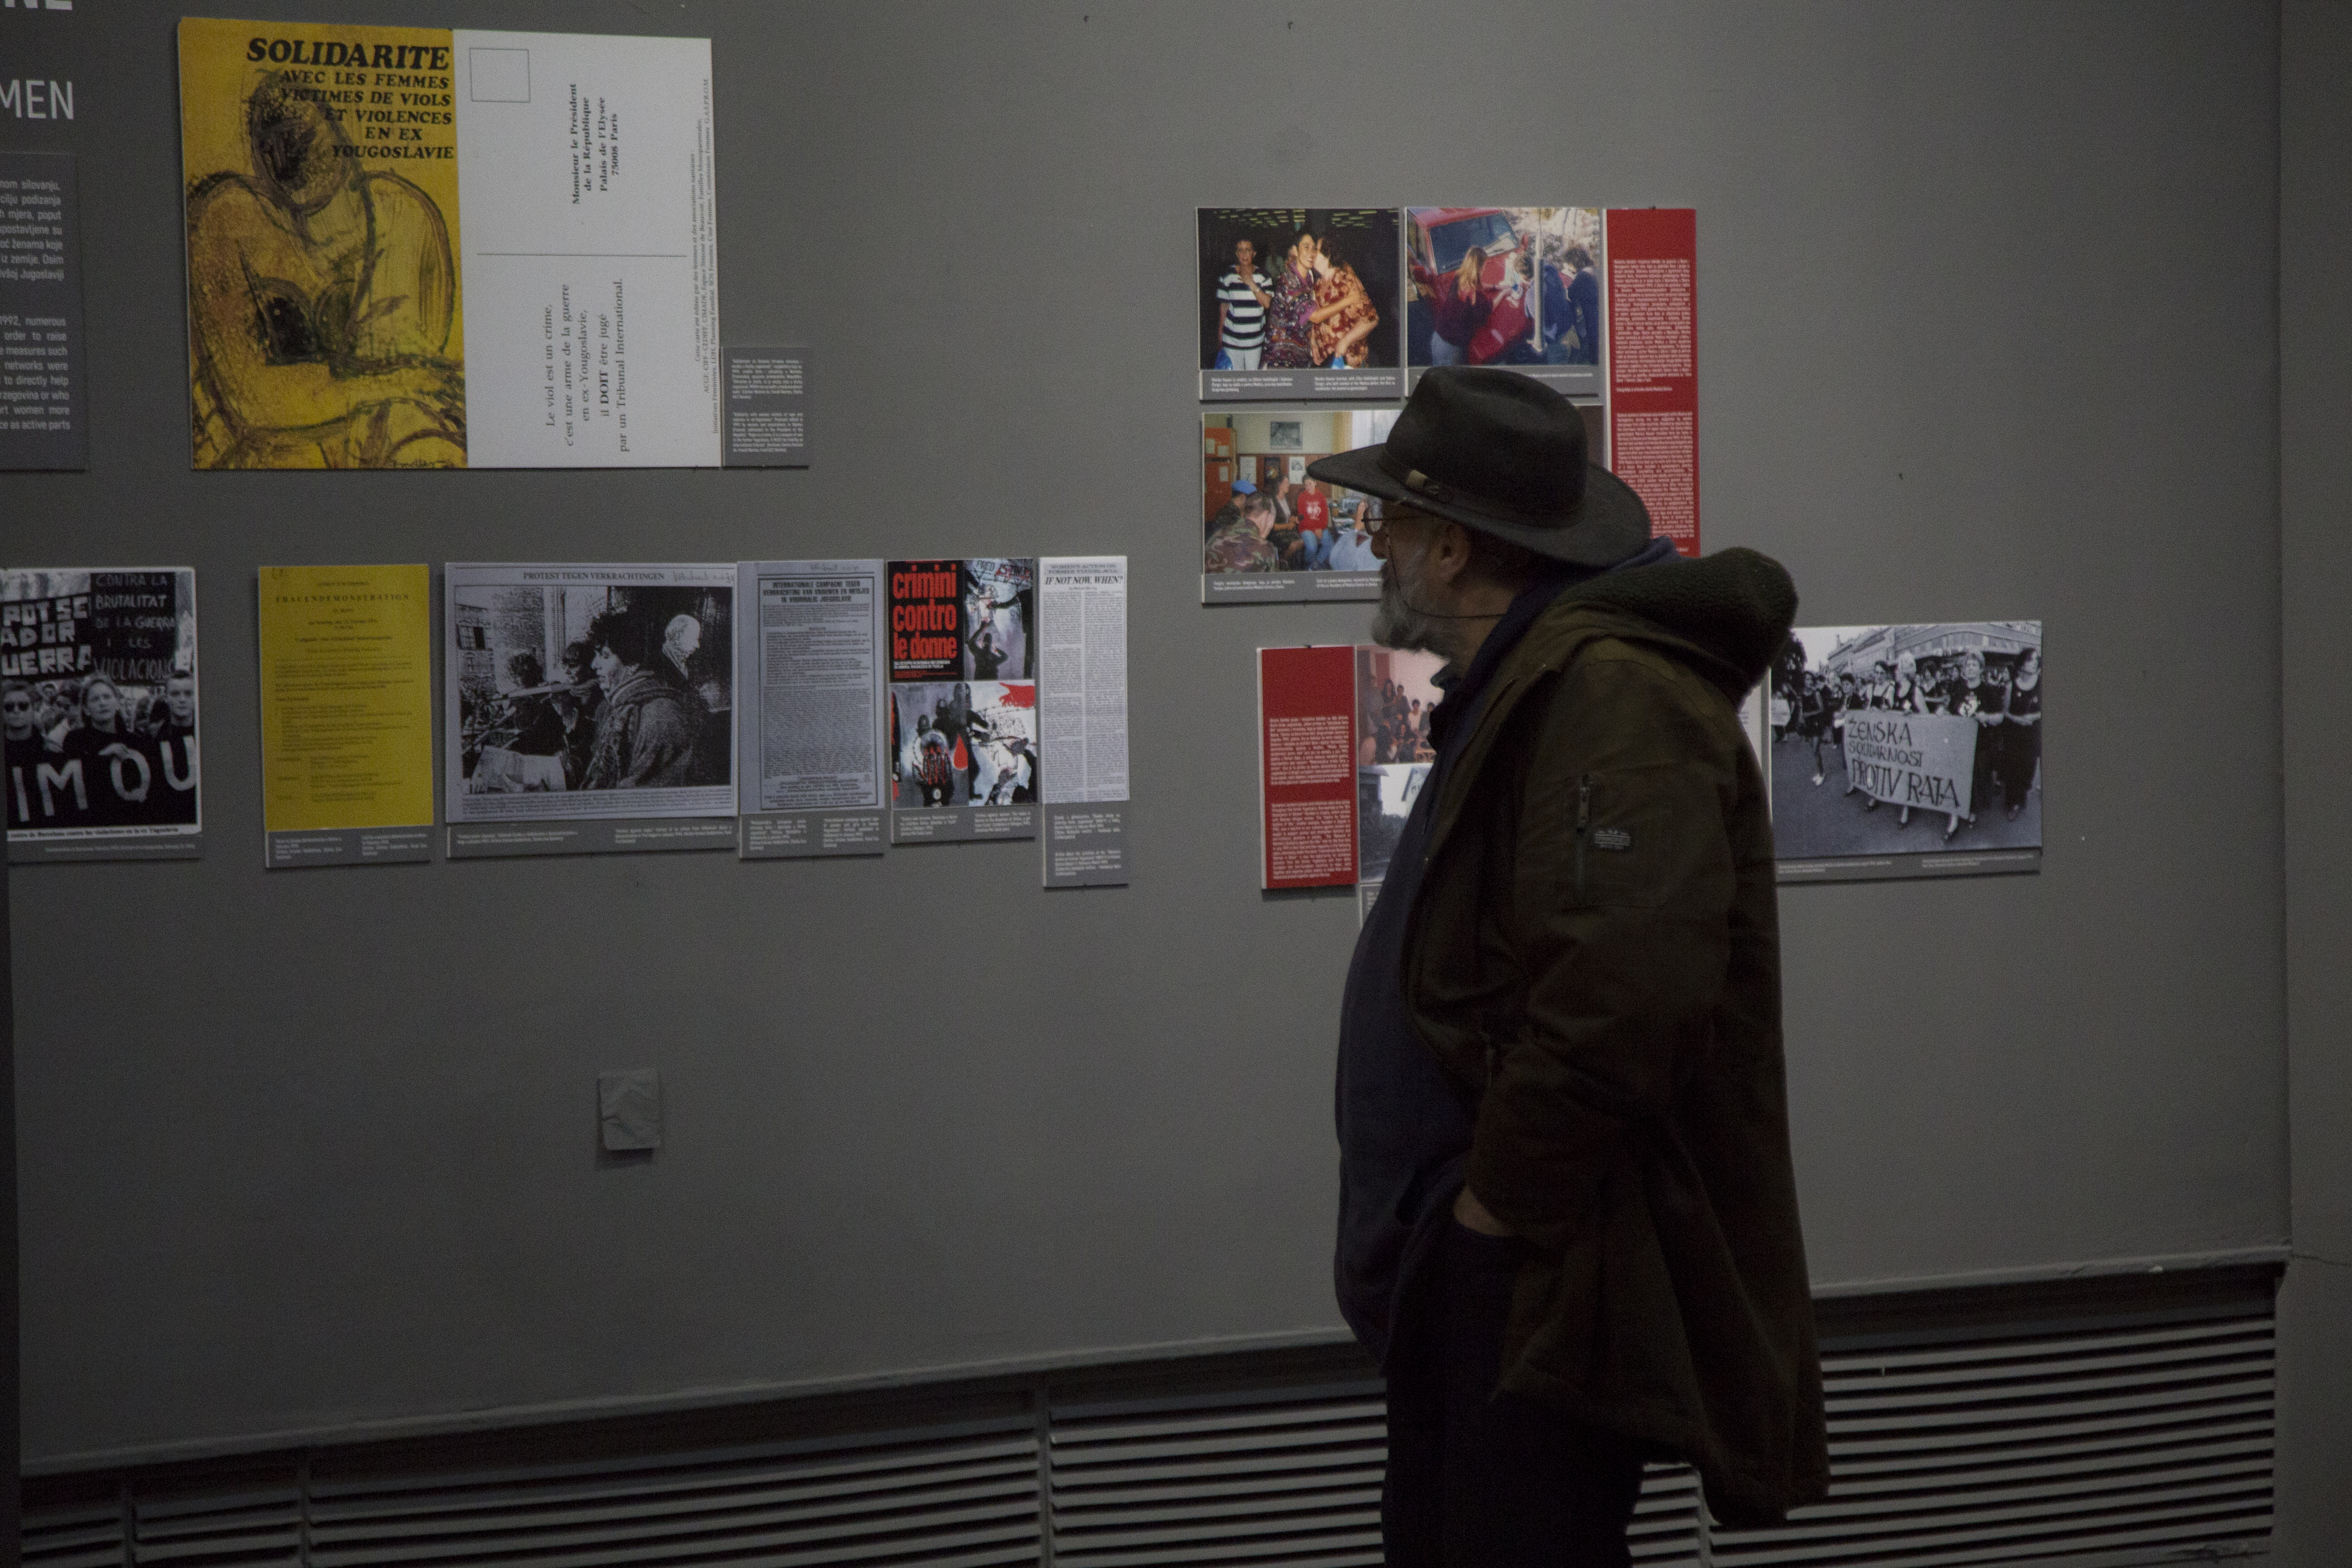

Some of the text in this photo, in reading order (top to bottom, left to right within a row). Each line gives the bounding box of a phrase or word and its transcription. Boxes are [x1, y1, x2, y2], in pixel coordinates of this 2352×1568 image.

[247, 38, 449, 70] SOLIDARITE
[280, 70, 449, 89] AVEC LES FEMMES
[281, 88, 451, 106] VICTIMES DE VIOLS
[325, 109, 452, 125] ET VIOLENCES
[365, 127, 423, 141] EN EX
[570, 83, 580, 204] Monsieur le Président
[582, 97, 592, 191] de la République
[599, 143, 606, 156] de
[333, 145, 454, 159] YOUGOSLAVIE
[599, 160, 608, 192] Palais
[52, 227, 63, 235] su
[46, 239, 63, 251] koje
[42, 254, 63, 264] Osim
[561, 284, 572, 322] guerre
[25, 317, 66, 327] numerous
[543, 304, 553, 340] crime,
[599, 314, 610, 338] jugé
[4, 331, 67, 341] order to raise
[561, 327, 570, 337] la
[5, 347, 46, 356] measures
[48, 345, 68, 356] such
[545, 345, 553, 360] un
[561, 342, 571, 356] de
[599, 343, 608, 365] être
[4, 360, 68, 371] networks were
[613, 279, 630, 452] par un Tribunal International.
[4, 375, 69, 387] to directly help
[564, 361, 572, 390] arme
[41, 391, 50, 400] or
[51, 390, 70, 400] who
[599, 371, 609, 405] DOIT
[545, 386, 554, 407] viol
[13, 406, 70, 415] women more
[582, 408, 589, 421] en
[10, 421, 20, 429] as
[22, 420, 47, 429] active
[48, 420, 70, 431] parts
[546, 412, 555, 427] Le
[96, 574, 168, 587] CONTRA LA
[590, 572, 664, 580] VERKRACHTINGEN
[893, 564, 956, 599] crimini
[1045, 577, 1053, 585] IF
[1055, 576, 1072, 585] NOT
[96, 594, 167, 610] BRUTALITAT
[893, 598, 957, 631] contro
[893, 631, 957, 659] le donne
[1849, 718, 1912, 747] ŽENSKA
[1852, 758, 1960, 808] PROTIV RATA
